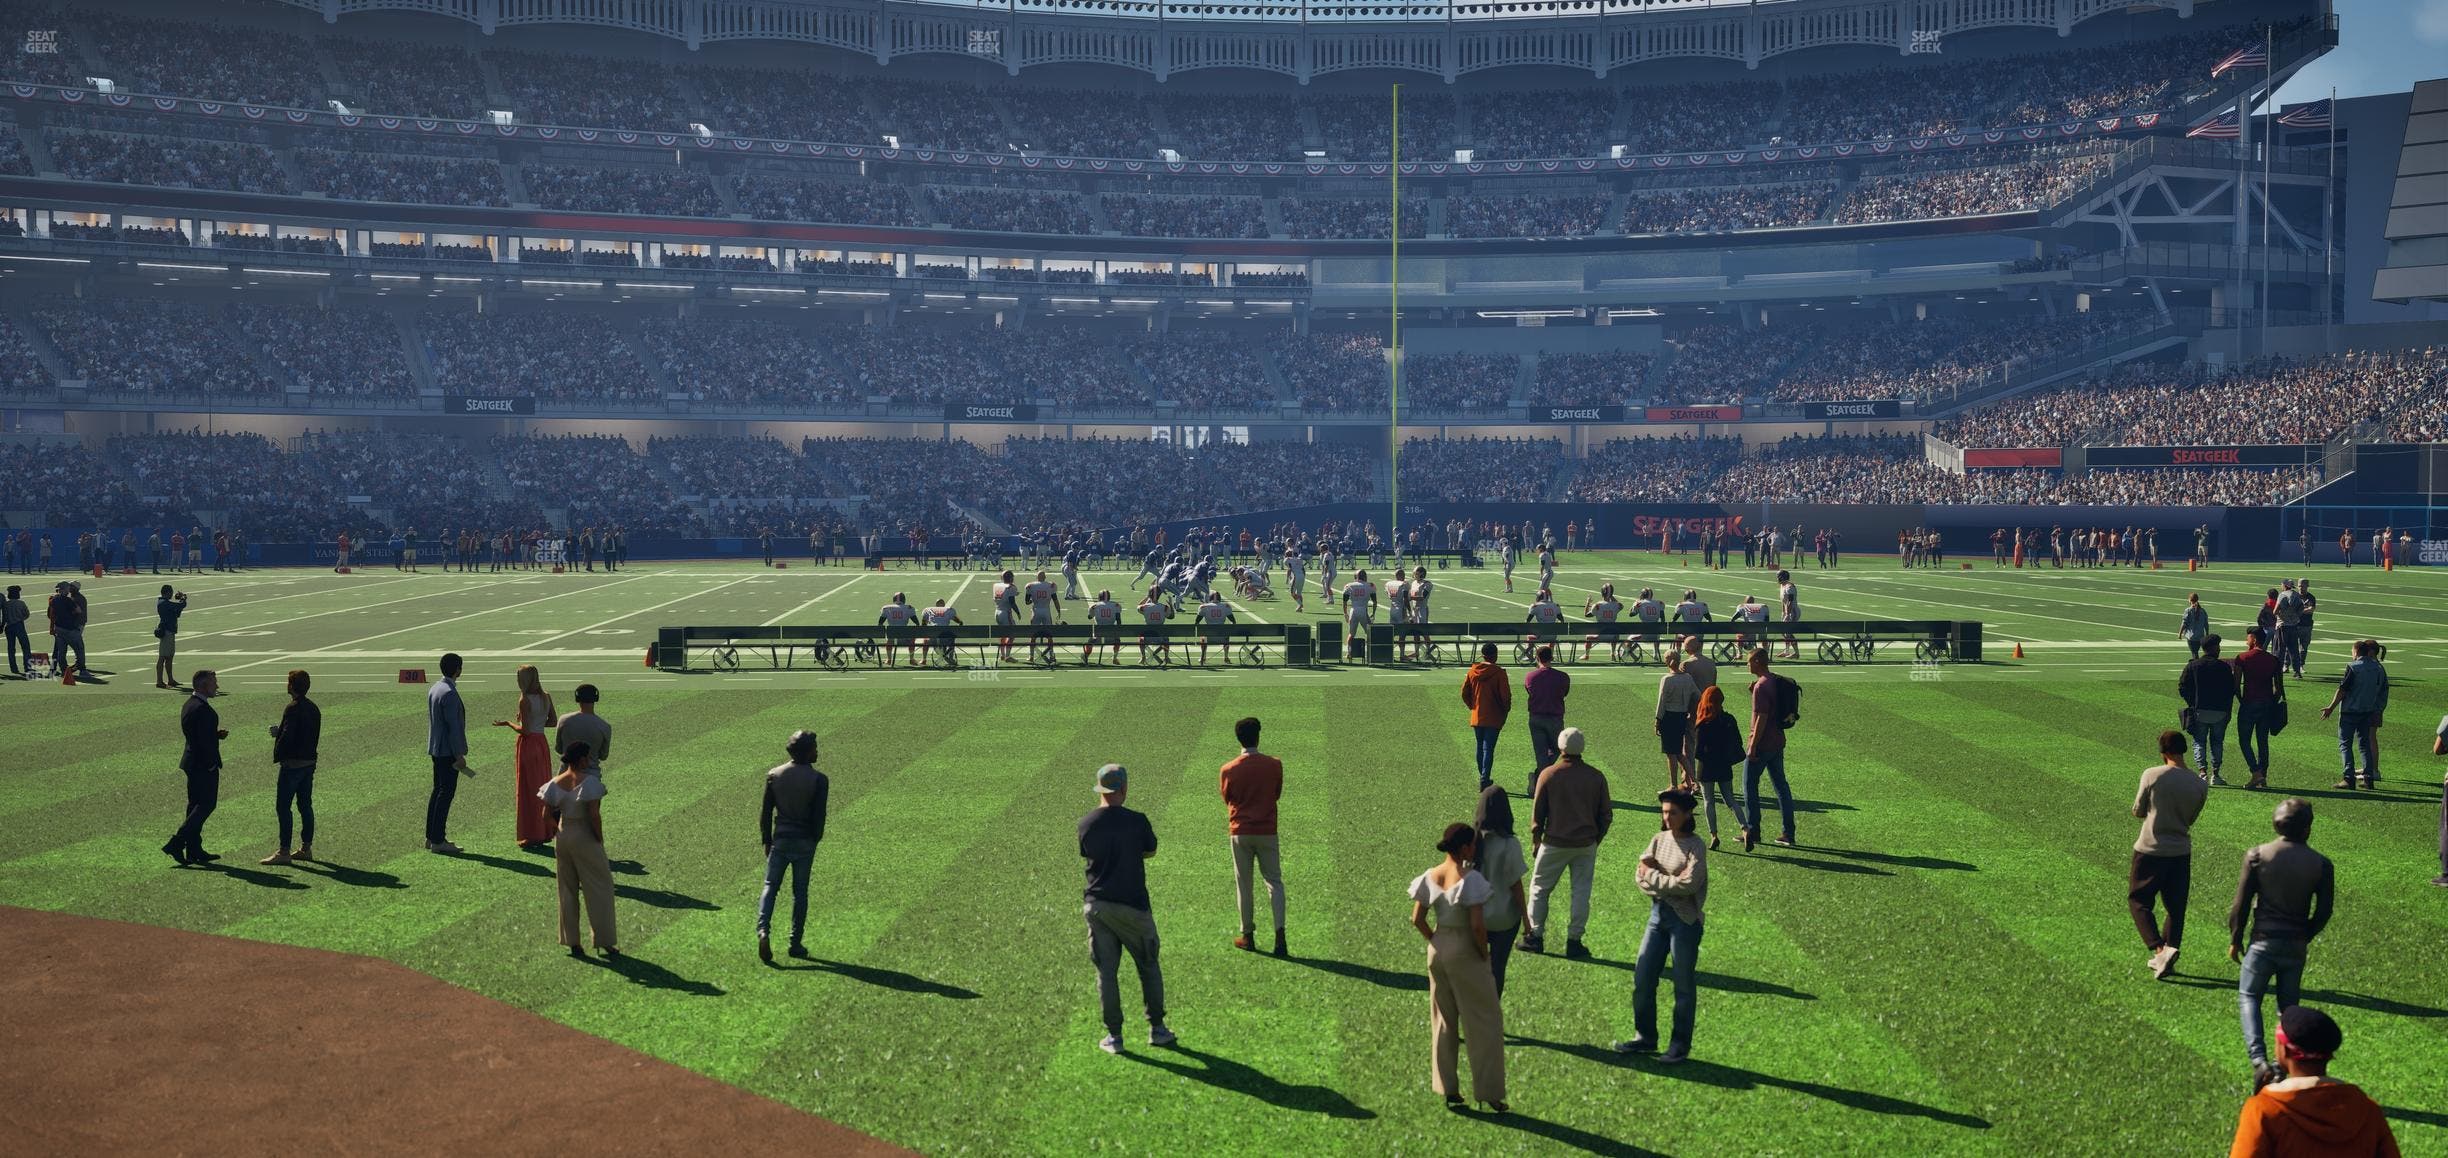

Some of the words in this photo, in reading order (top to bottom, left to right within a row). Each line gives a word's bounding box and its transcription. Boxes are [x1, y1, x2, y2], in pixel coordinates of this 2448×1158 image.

[466, 399, 513, 412] SEATGEEK
[1826, 403, 1876, 416] SEATGEEK
[966, 406, 1014, 418] SEATGEEK
[1551, 408, 1600, 420] SEATGEEK
[1670, 410, 1719, 420] SEATGEEK
[2172, 448, 2240, 464] SEATGEEK
